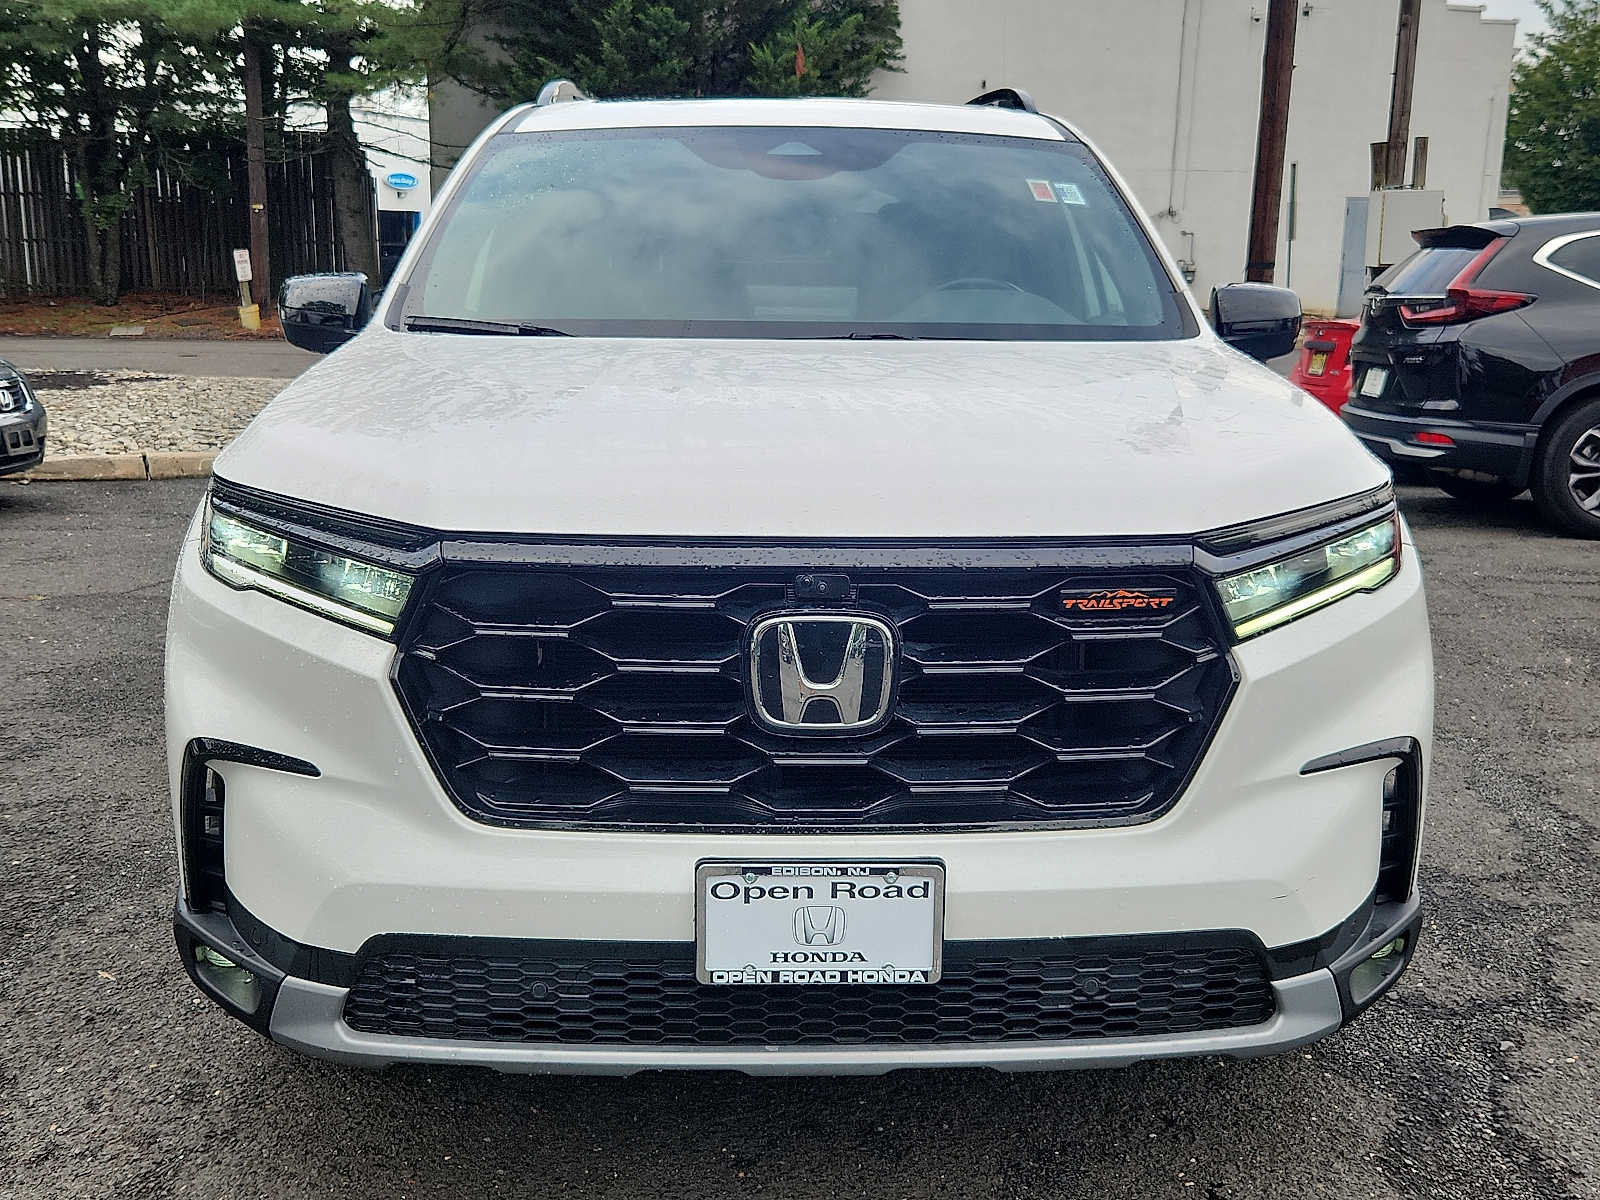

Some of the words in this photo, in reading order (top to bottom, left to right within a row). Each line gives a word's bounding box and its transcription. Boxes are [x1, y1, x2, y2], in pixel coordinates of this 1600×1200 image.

[1062, 598, 1174, 610] TRAILSPORT
[847, 866, 870, 876] NJ
[710, 881, 814, 904] Open
[831, 881, 930, 899] Road
[770, 951, 868, 963] HONDA
[712, 970, 772, 983] OPEN
[779, 970, 841, 983] ROAD
[847, 970, 926, 983] HONDA
